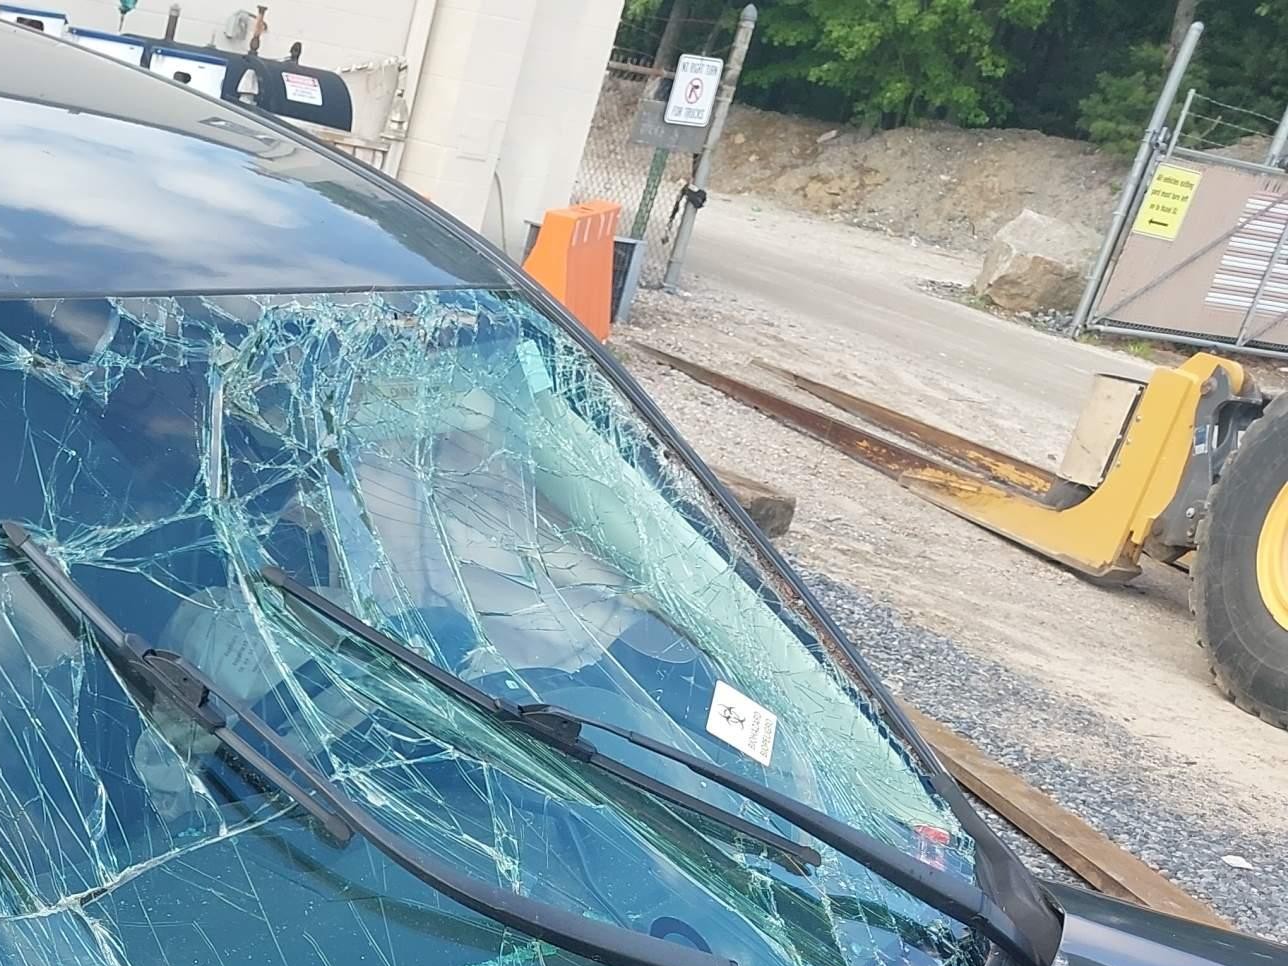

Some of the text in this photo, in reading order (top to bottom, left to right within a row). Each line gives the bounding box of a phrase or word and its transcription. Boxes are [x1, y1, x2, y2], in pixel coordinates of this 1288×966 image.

[690, 62, 704, 74] RIGHT
[704, 64, 718, 76] TURN
[747, 711, 762, 751] BIOHAZARD
